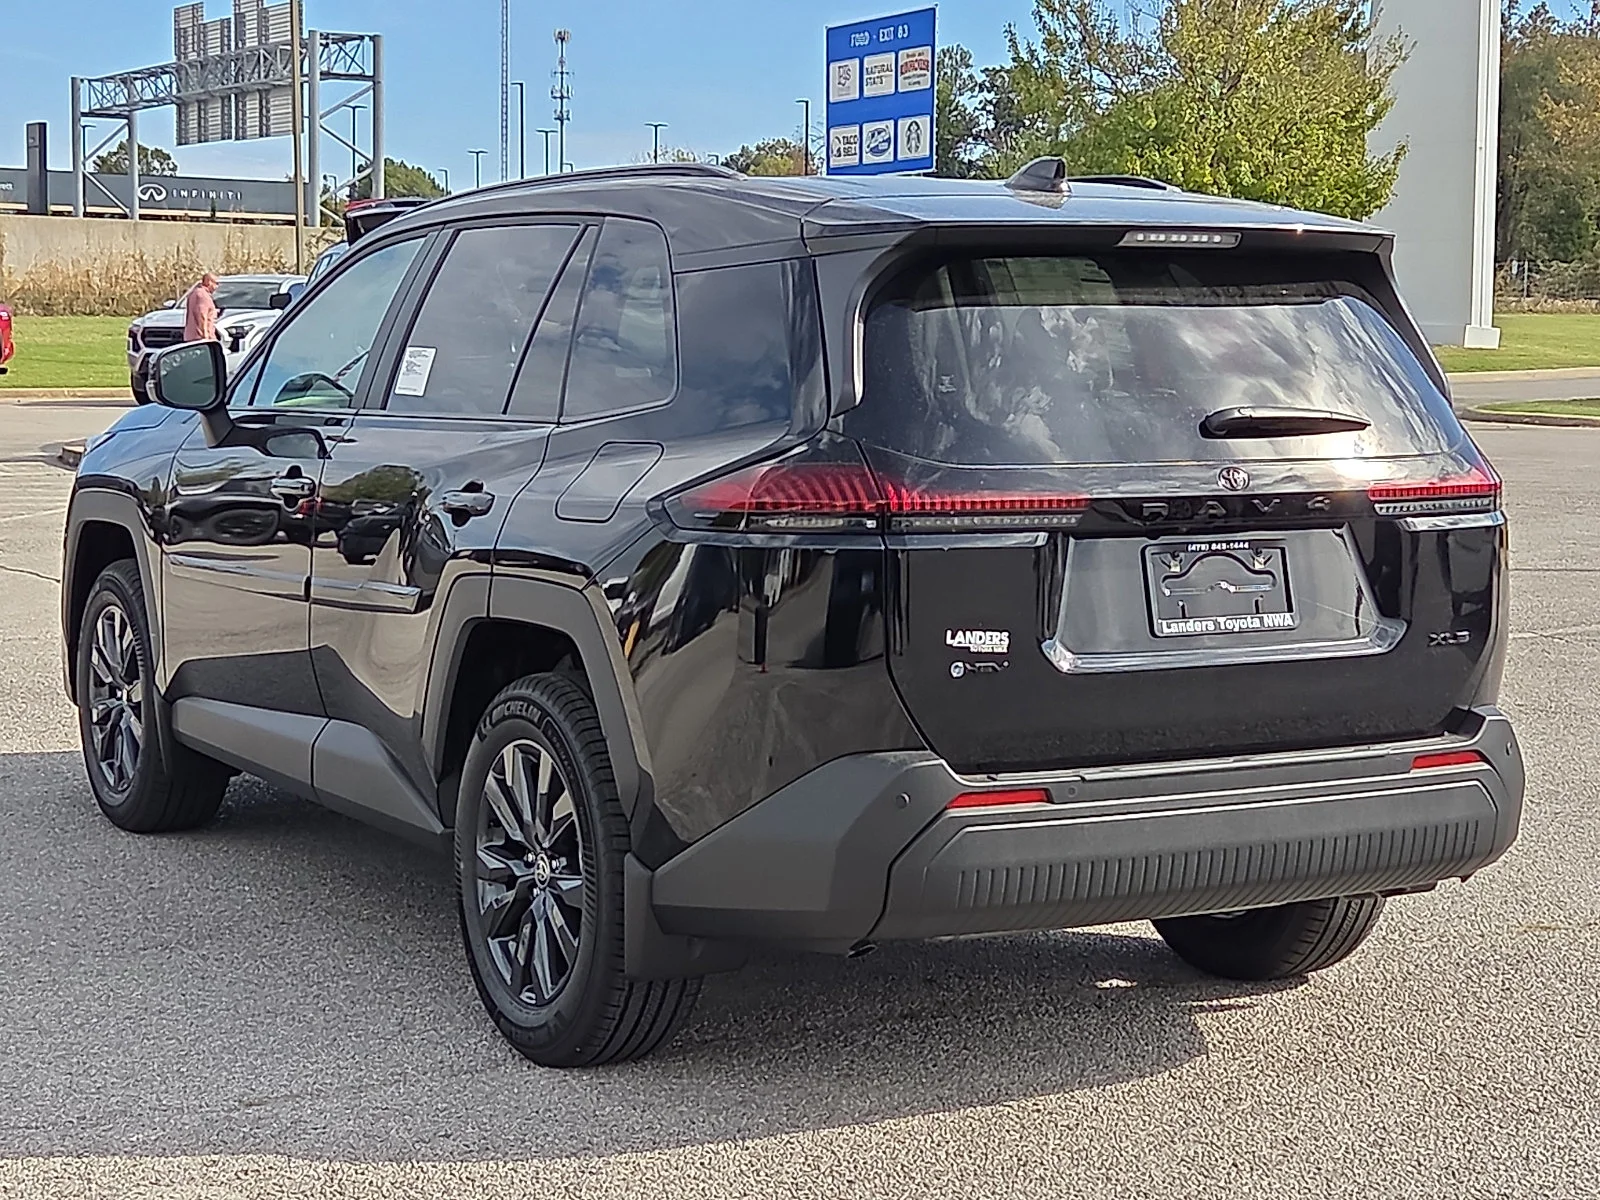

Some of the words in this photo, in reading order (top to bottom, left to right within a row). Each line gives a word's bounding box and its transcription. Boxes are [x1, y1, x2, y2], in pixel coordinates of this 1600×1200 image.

[850, 31, 870, 47] FOOD
[879, 26, 895, 42] EXIT
[897, 24, 909, 39] 83
[842, 135, 858, 146] TACO
[842, 146, 858, 157] BELL
[172, 188, 242, 200] INFINITI
[1161, 619, 1216, 634] Landers
[1217, 615, 1262, 633] Toyota
[1263, 613, 1294, 628] NWA
[946, 629, 1009, 645] LANDERS
